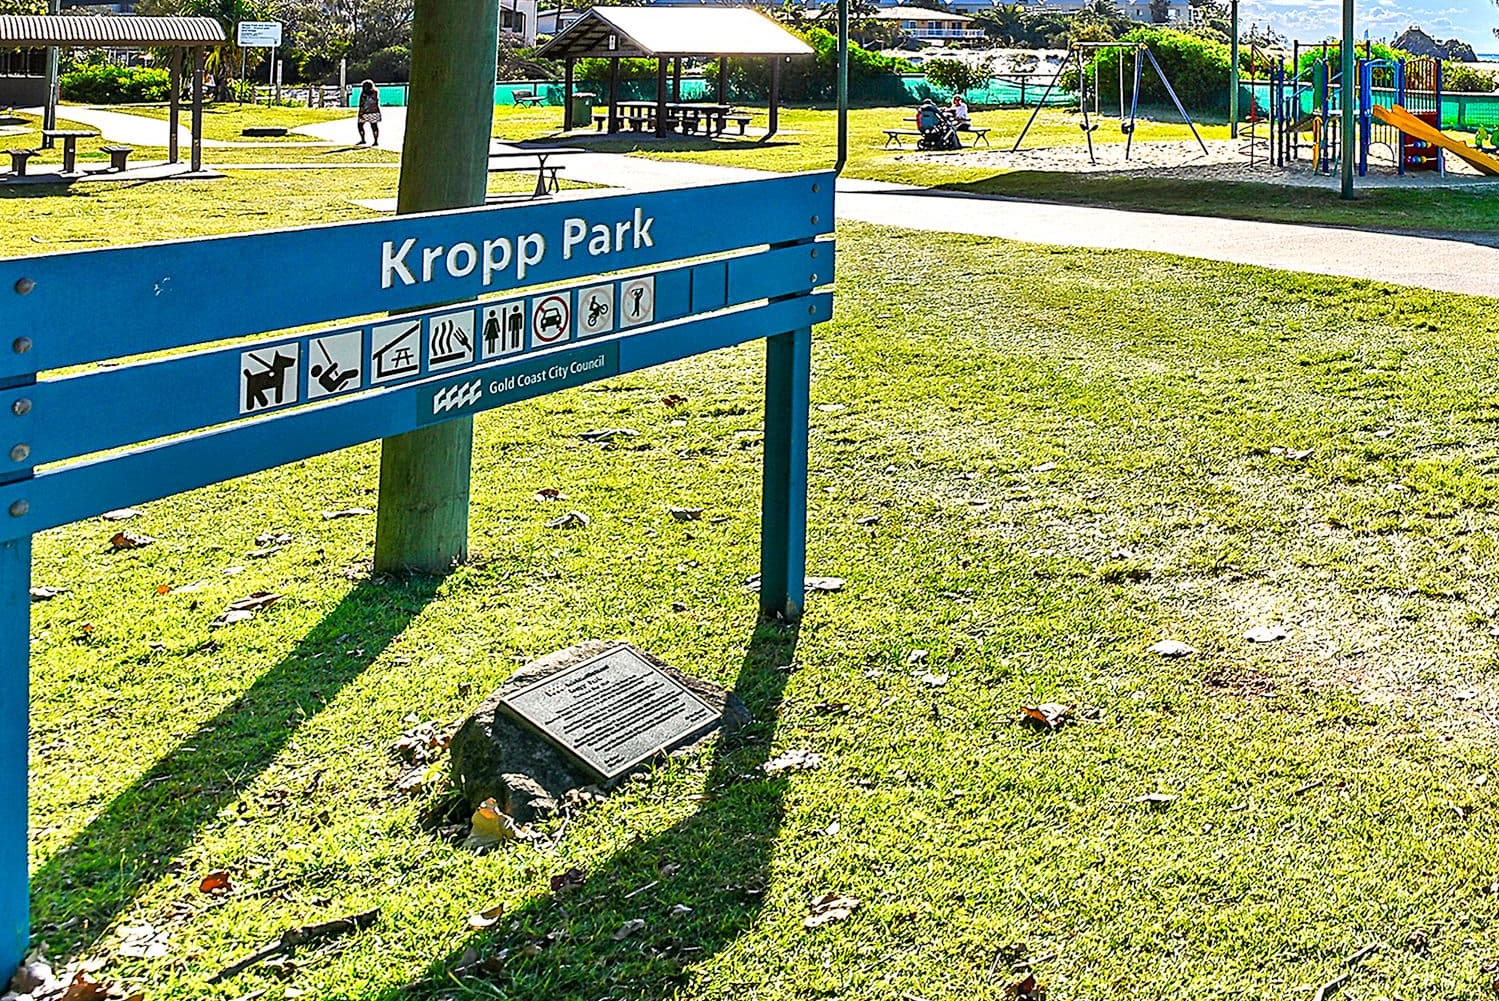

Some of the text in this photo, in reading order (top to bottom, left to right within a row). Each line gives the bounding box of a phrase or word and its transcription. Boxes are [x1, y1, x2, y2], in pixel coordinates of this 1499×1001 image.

[381, 207, 655, 289] Kropp Park
[489, 354, 605, 394] Gold Coast City Council
